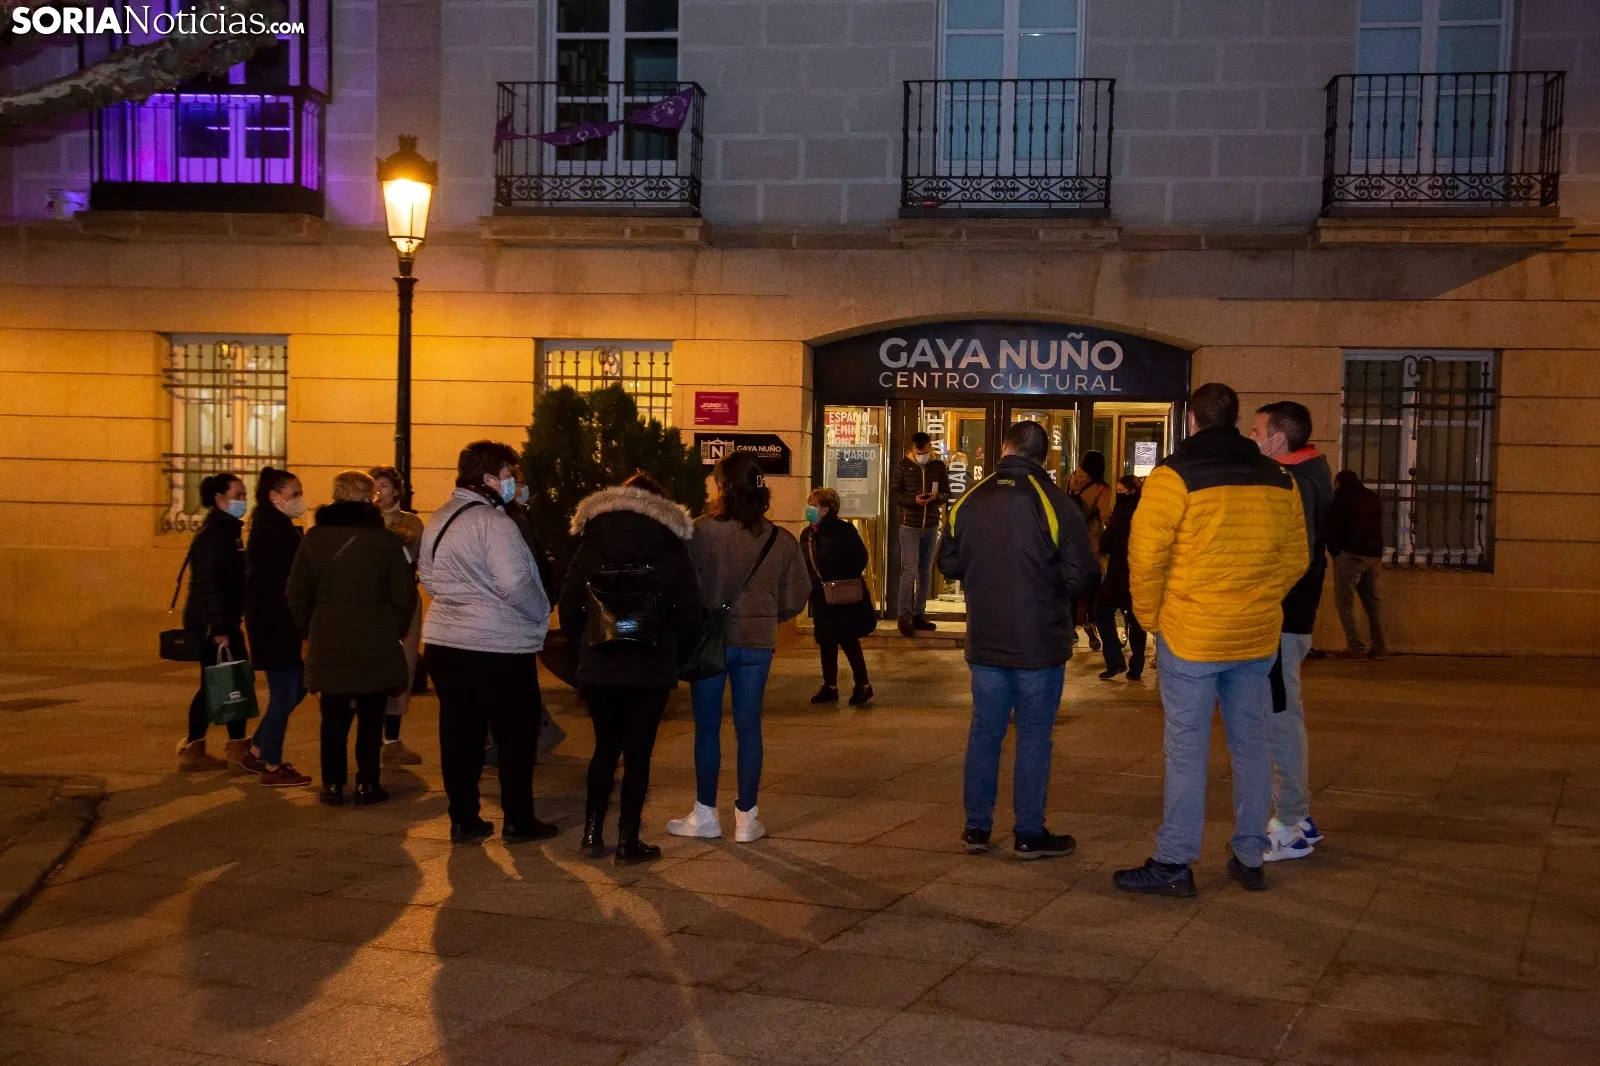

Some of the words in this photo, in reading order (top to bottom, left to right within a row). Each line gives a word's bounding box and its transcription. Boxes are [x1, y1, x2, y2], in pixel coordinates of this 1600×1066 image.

[879, 337, 991, 369] GAYA
[999, 332, 1124, 371] NUÑO
[878, 371, 980, 389] CENTRO
[990, 372, 1122, 392] CULTURAL
[829, 411, 868, 423] ESPACIO
[927, 412, 945, 433] DE
[829, 424, 879, 436] FEMINSTA
[829, 436, 868, 447] ONCA
[758, 444, 782, 452] NUÑO
[828, 449, 841, 460] DE
[843, 449, 877, 460] MARCO
